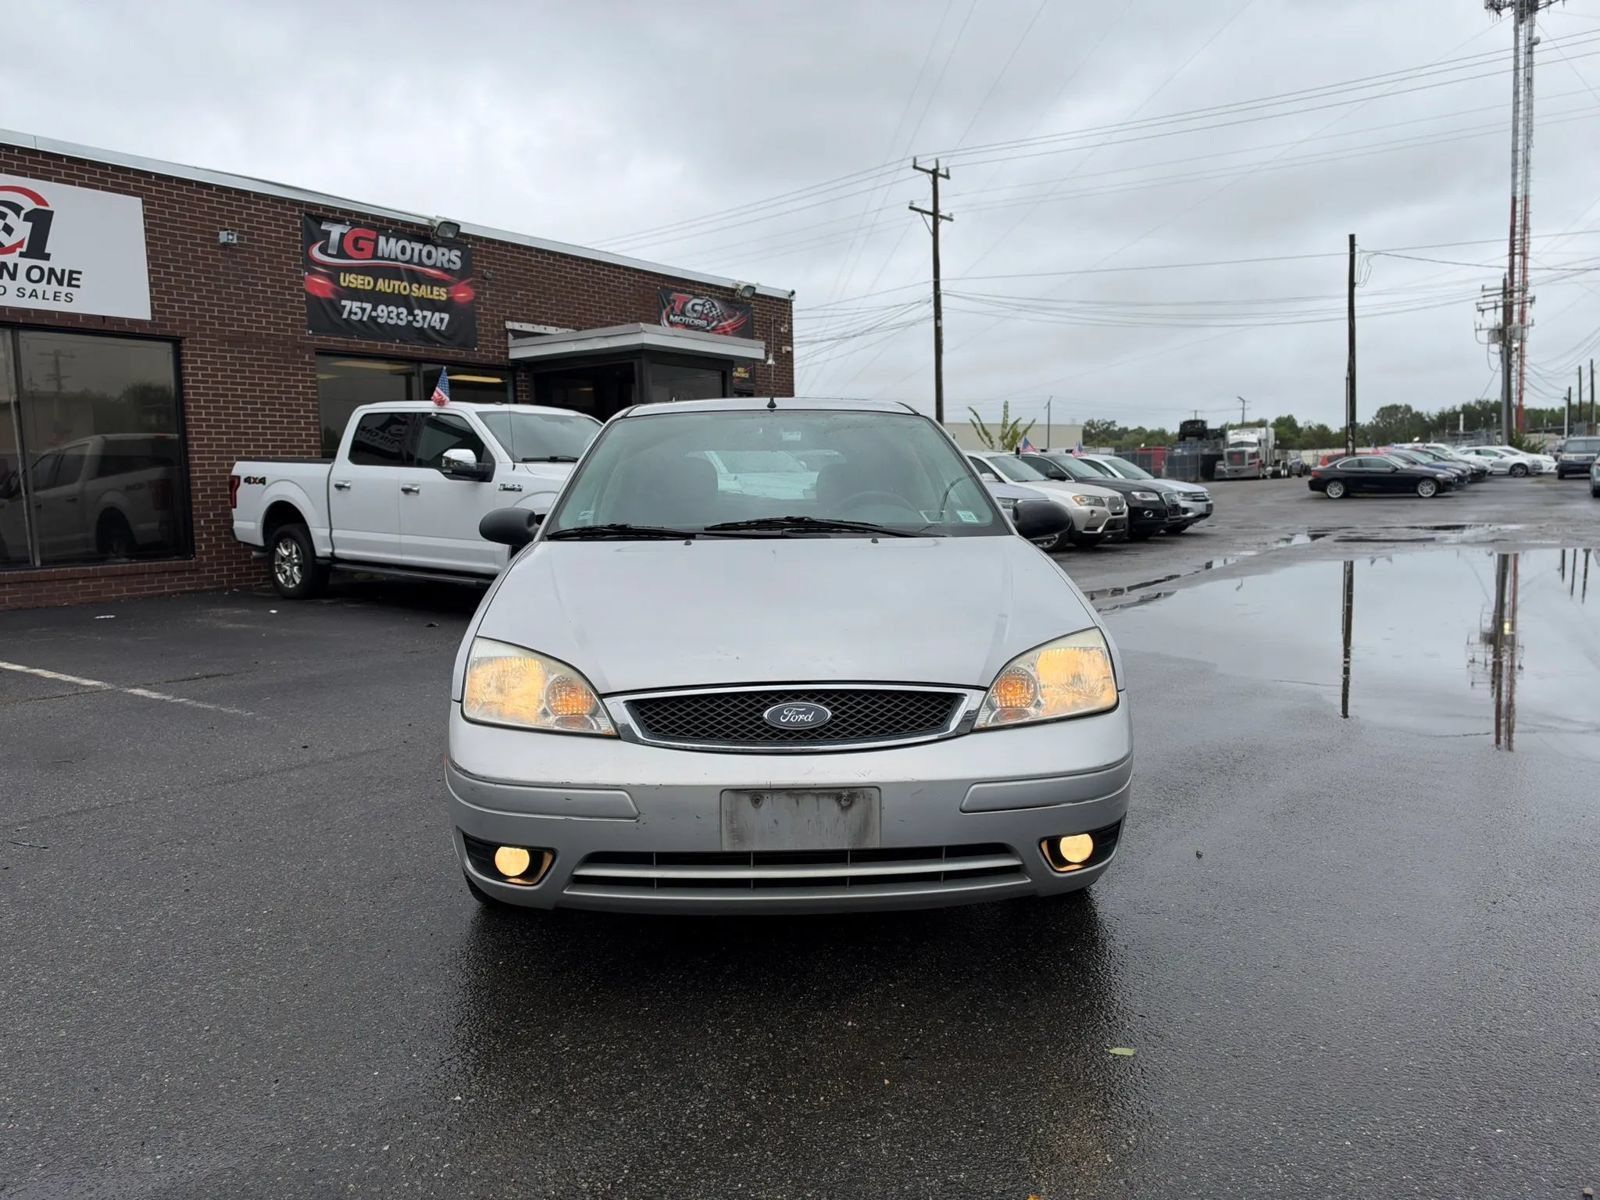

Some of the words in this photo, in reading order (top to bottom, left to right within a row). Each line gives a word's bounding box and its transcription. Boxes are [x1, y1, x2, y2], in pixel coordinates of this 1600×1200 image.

[321, 221, 377, 260] TG
[378, 235, 462, 270] MOTORS
[25, 265, 82, 289] ONE
[339, 272, 374, 290] USED
[375, 278, 410, 295] AUTO
[411, 283, 448, 301] SALES
[16, 287, 74, 303] SALES
[341, 300, 450, 331] 757-933-3747
[669, 314, 708, 327] MOTORS
[780, 707, 815, 722] Ford
